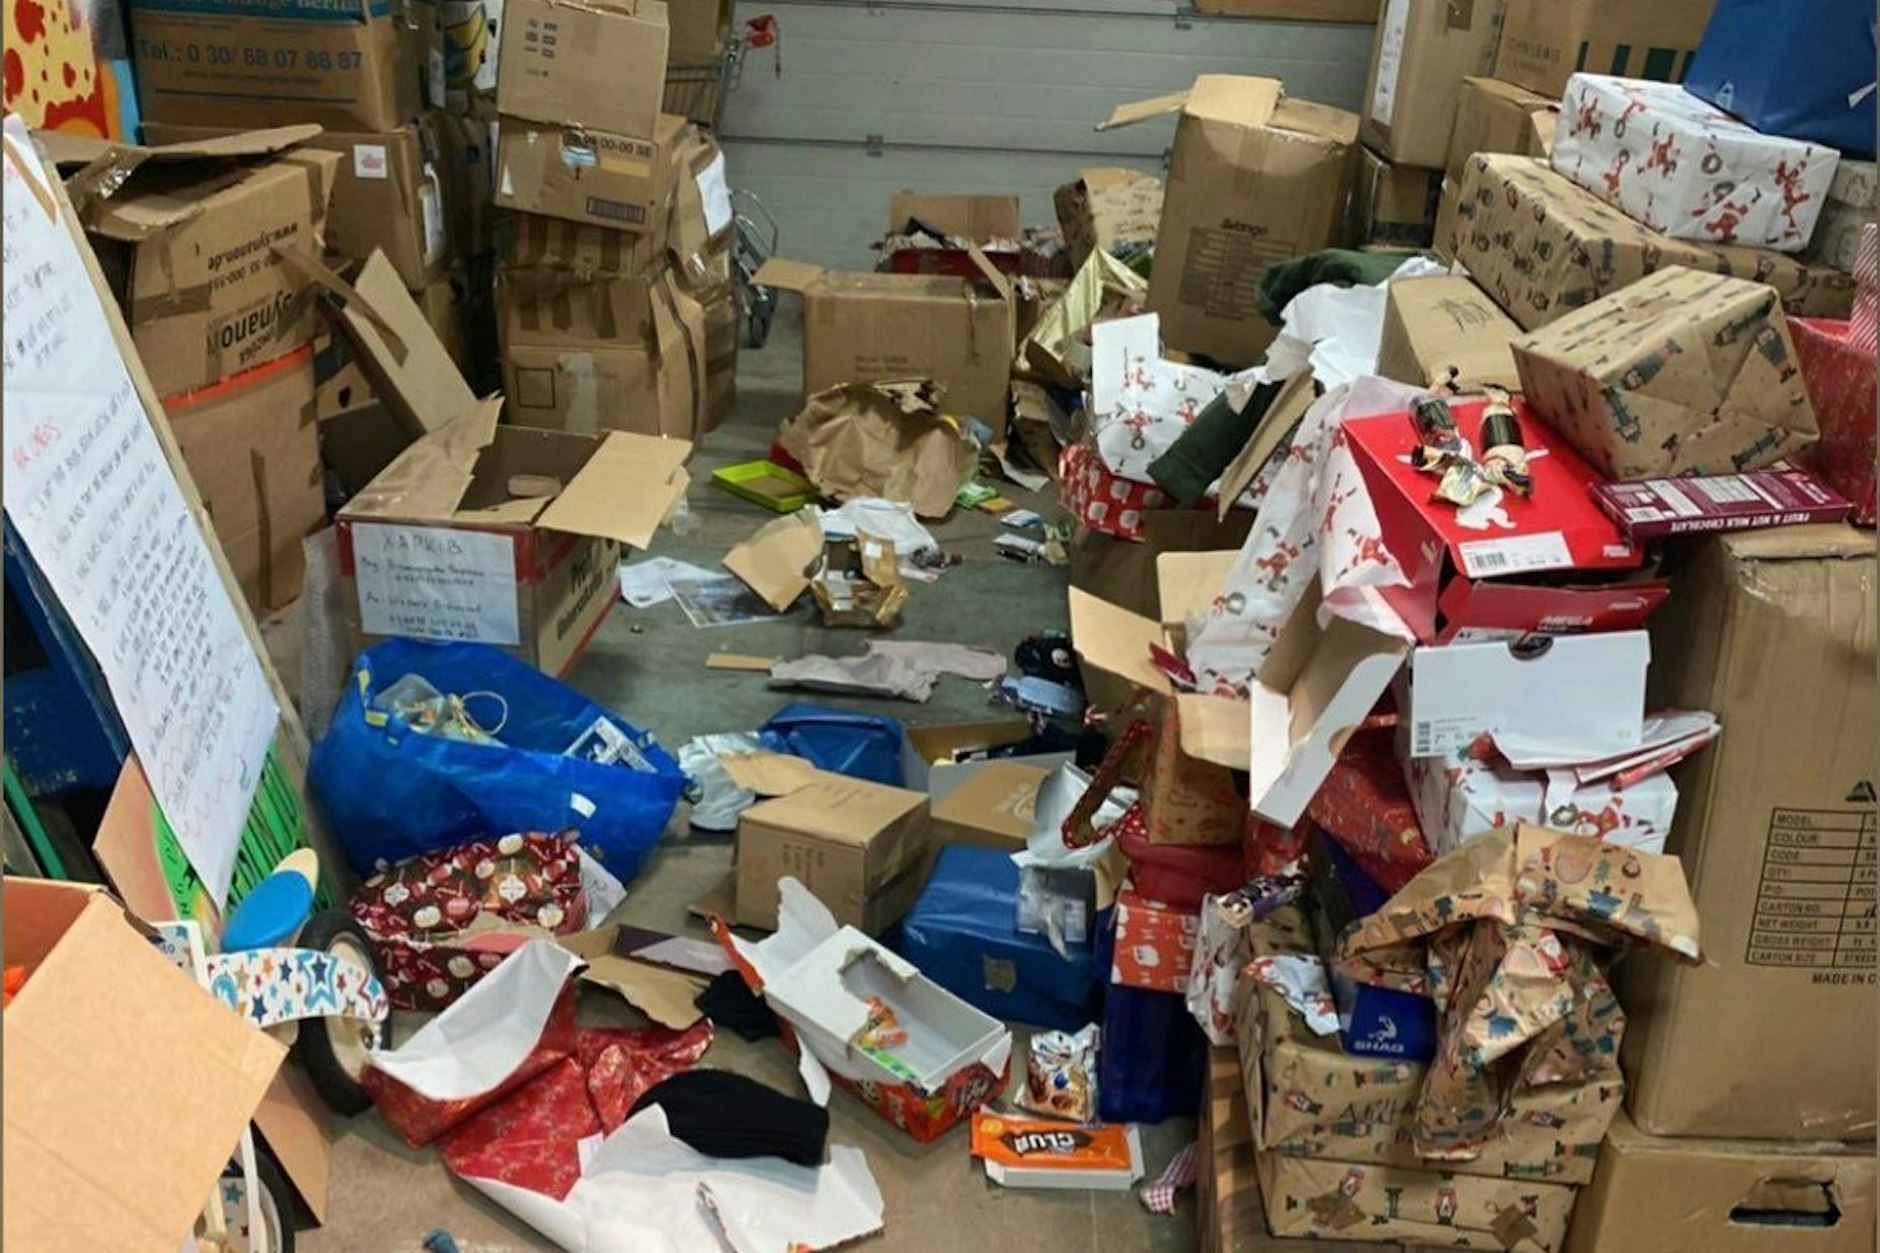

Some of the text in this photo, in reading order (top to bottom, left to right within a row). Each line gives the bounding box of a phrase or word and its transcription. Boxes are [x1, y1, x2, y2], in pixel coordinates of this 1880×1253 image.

[274, 49, 298, 69] 07
[337, 51, 362, 70] 87
[1727, 516, 1751, 529] MILK
[1752, 514, 1771, 526] NUT
[1781, 511, 1811, 524] FRUIT
[1670, 518, 1725, 532] CHOCOLATE
[1812, 972, 1848, 985] MADE
[1850, 974, 1865, 985] IN
